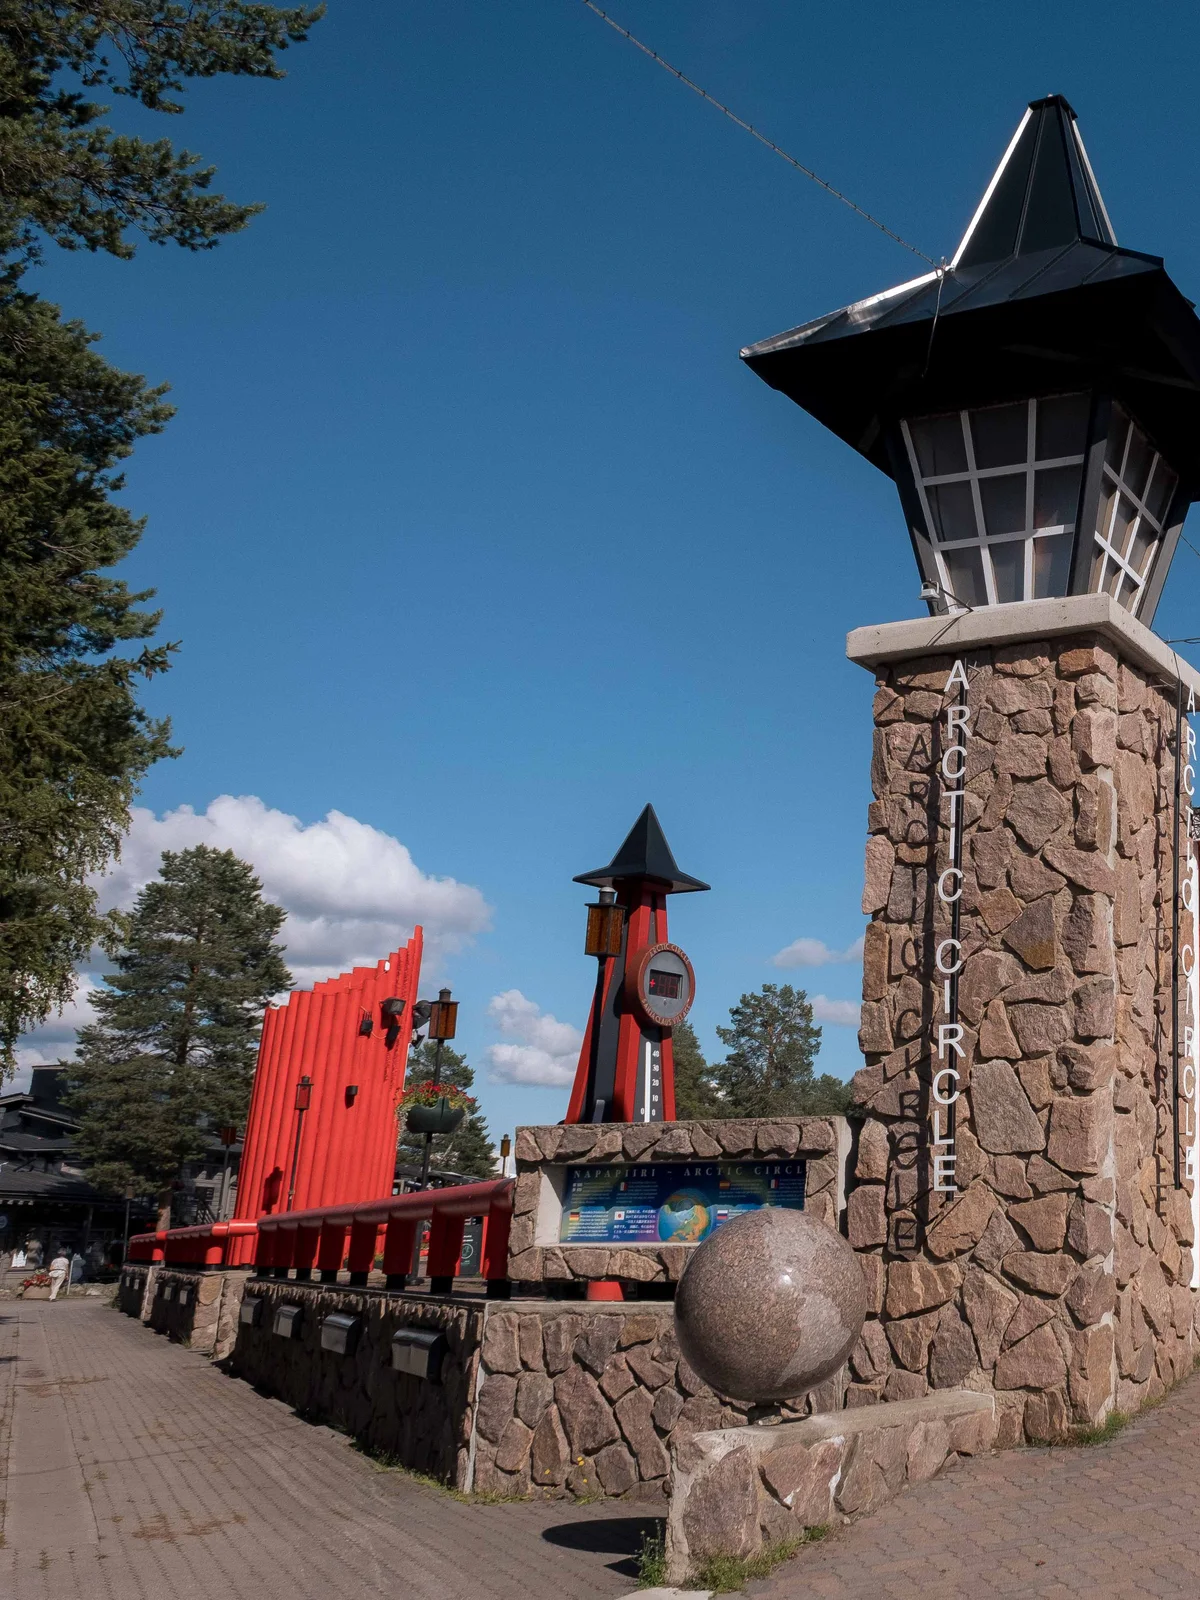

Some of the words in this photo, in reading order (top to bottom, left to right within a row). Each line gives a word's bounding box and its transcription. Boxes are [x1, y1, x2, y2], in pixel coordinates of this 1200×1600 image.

[937, 659, 973, 902] ARCTIC
[1182, 684, 1197, 913] ARCTIC
[649, 943, 670, 957] ARCTIC
[671, 944, 690, 965] CIRCLE
[655, 1015, 672, 1026] CLAUS
[652, 1050, 660, 1058] 40
[932, 938, 966, 1192] CIRCLE
[1181, 944, 1195, 1180] CIRCLE
[652, 1064, 660, 1072] 30
[652, 1078, 660, 1087] 20
[652, 1094, 659, 1102] 10
[640, 1107, 645, 1116] 0
[652, 1109, 656, 1117] 0
[573, 1168, 656, 1179] NAPAPIIRI
[684, 1166, 743, 1177] ARCTIC
[754, 1165, 803, 1176] CIRCL
